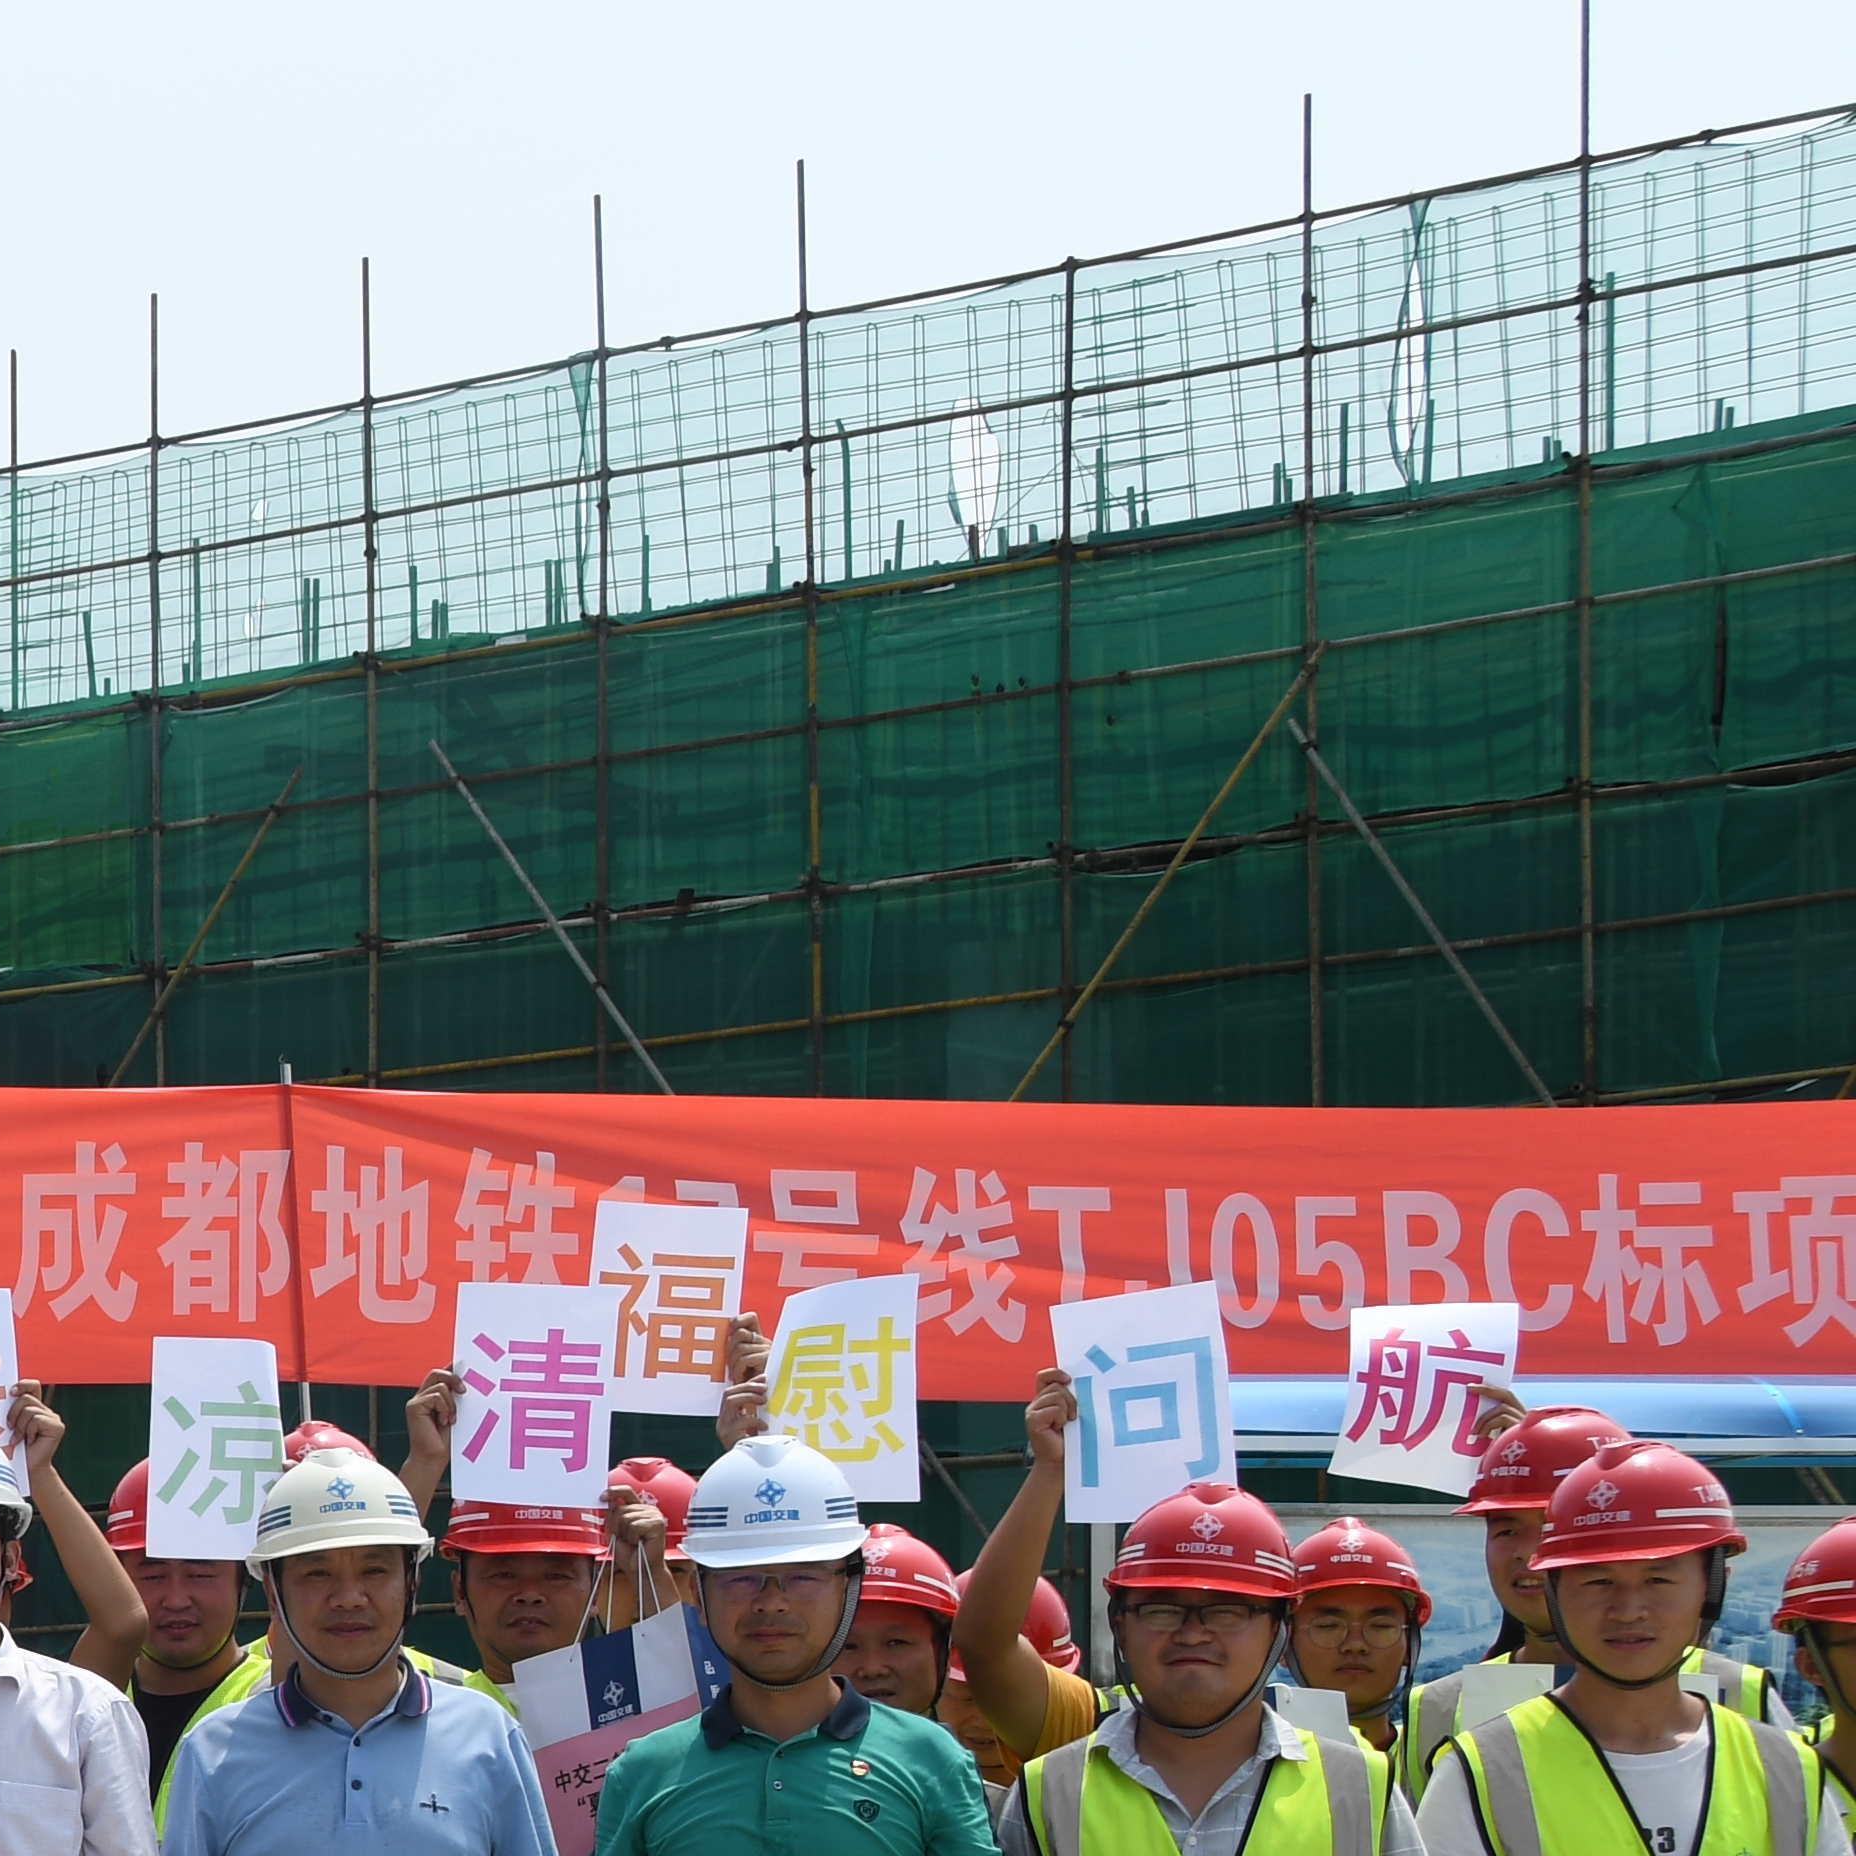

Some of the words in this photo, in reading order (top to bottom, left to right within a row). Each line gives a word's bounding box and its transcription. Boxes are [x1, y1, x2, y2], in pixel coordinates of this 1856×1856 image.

[601, 1244, 735, 1380] 福
[768, 1317, 911, 1462] 慰
[1345, 1328, 1506, 1457] 航
[463, 1328, 603, 1474] 清
[1075, 1336, 1218, 1489] 问
[156, 1380, 287, 1525] 凉
[1490, 1466, 1531, 1478] 中国交建
[319, 1501, 368, 1514] 中国交建
[514, 1509, 564, 1521] 中国交建
[744, 1509, 800, 1525] 中国交建
[1573, 1510, 1631, 1527] 中国交建
[1175, 1542, 1234, 1557] 中国交建
[1329, 1554, 1373, 1564] 中国交建
[598, 1704, 634, 1723] 中国交建
